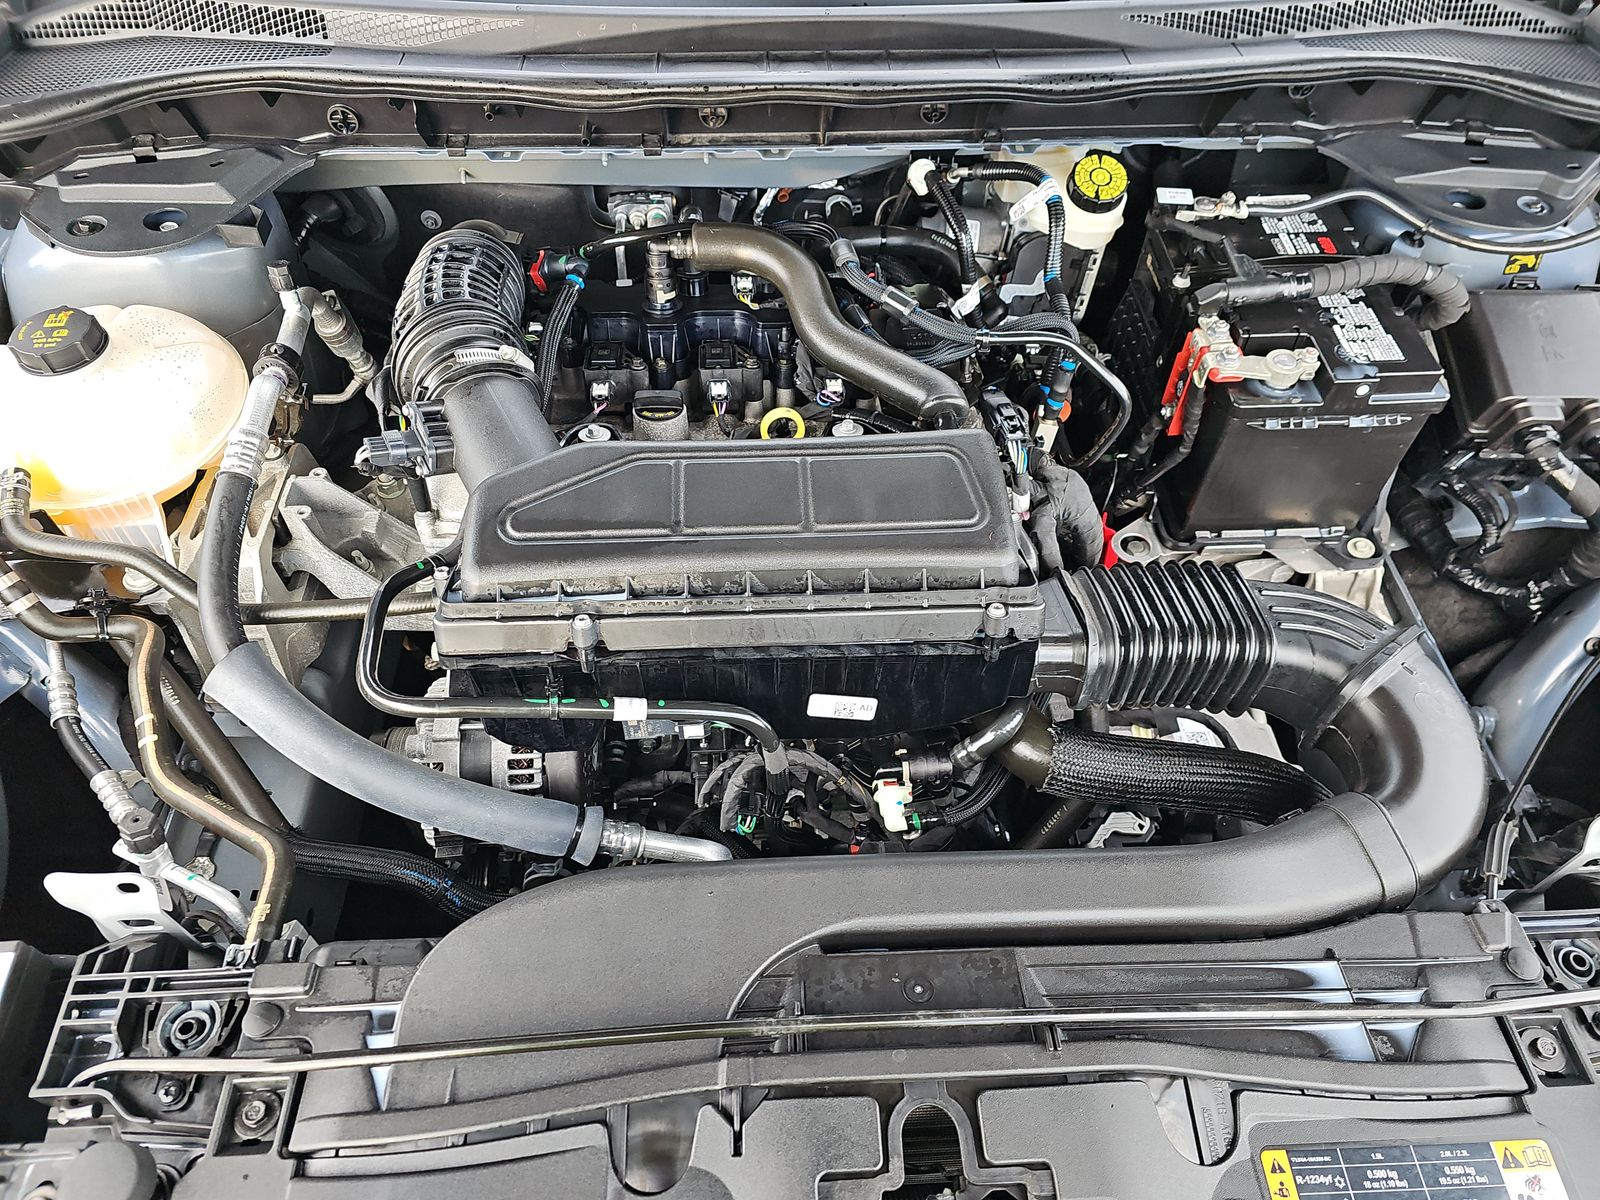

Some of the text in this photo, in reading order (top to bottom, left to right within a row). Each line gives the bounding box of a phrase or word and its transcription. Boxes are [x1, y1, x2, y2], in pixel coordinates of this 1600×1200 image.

[1366, 1169, 1399, 1180] 0.500 kg
[1444, 1165, 1476, 1176] 0.550 kg
[1295, 1174, 1333, 1185] R-1234yf
[1363, 1180, 1372, 1189] 18
[1395, 1179, 1409, 1189] lbs)
[1475, 1175, 1489, 1185] lbs)
